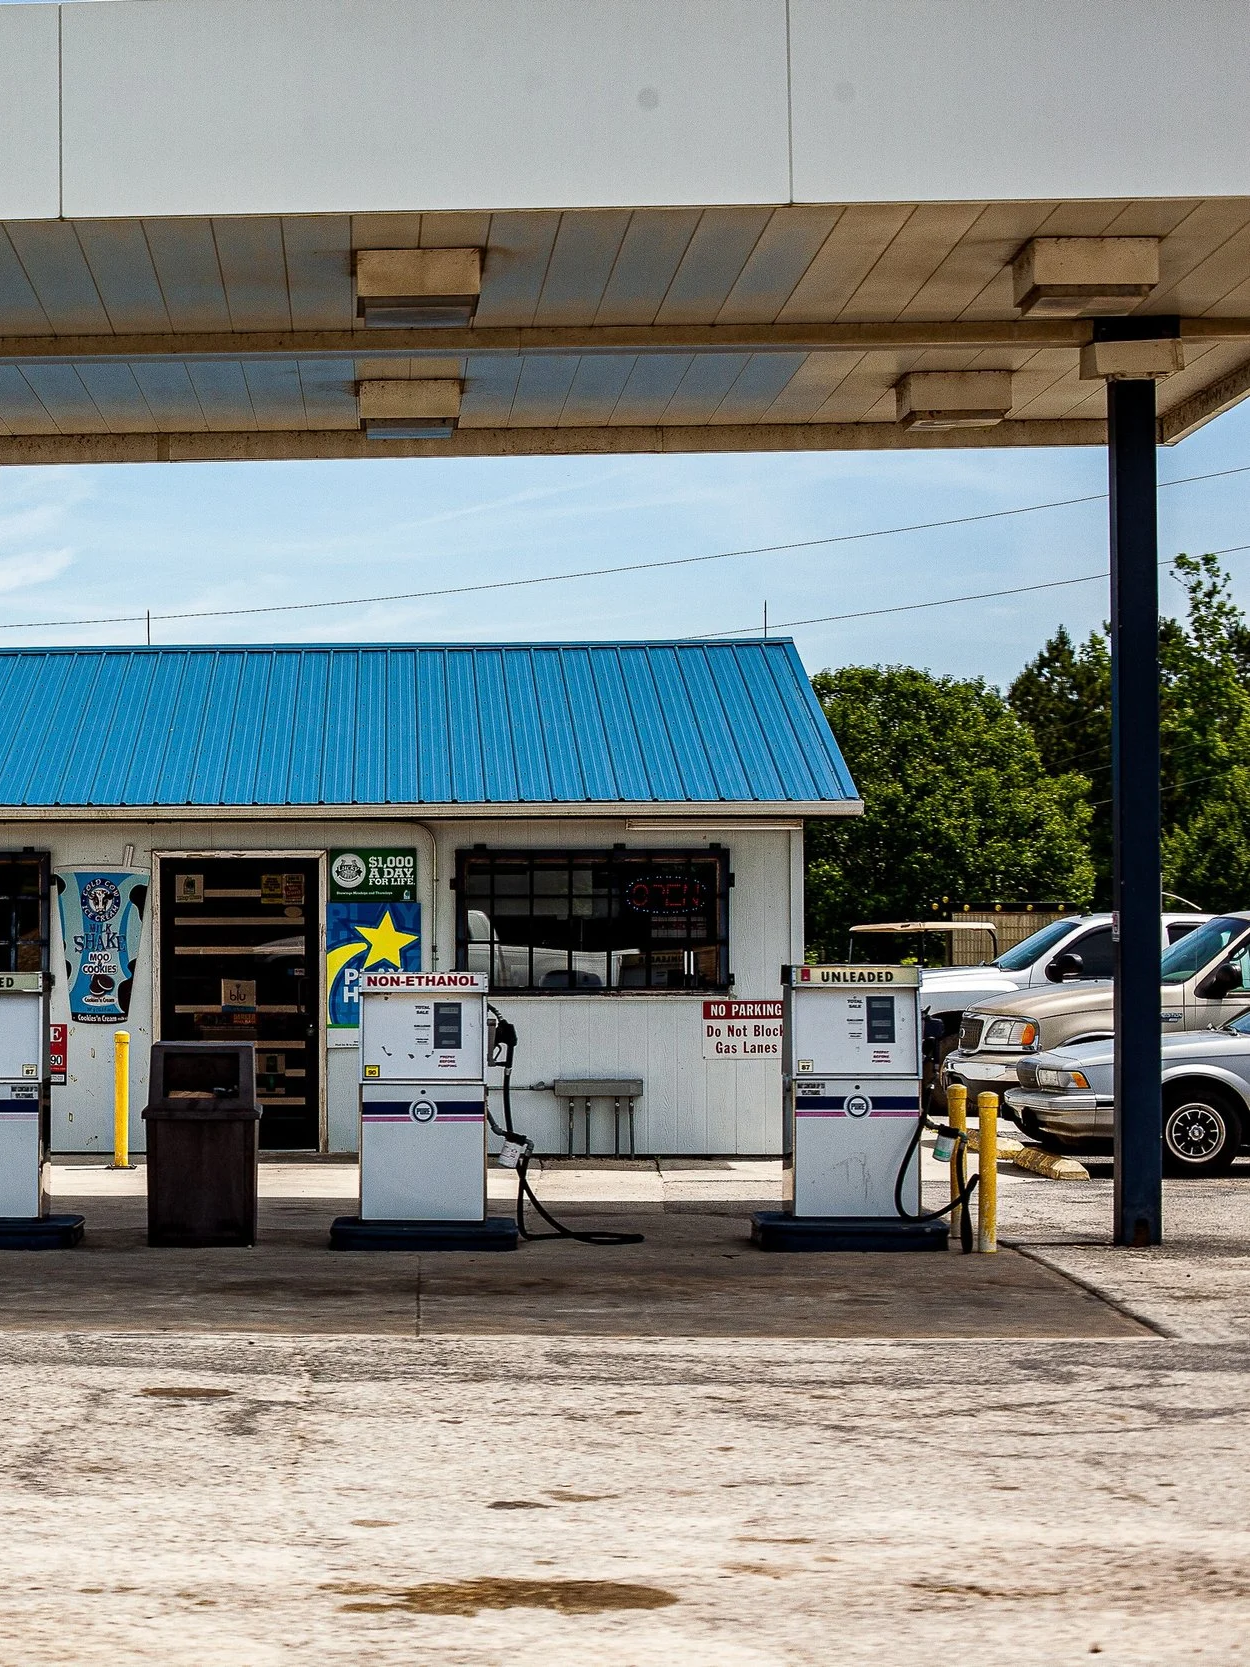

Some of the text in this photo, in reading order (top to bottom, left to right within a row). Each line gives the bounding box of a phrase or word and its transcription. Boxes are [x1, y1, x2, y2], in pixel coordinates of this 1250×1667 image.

[368, 856, 414, 868] $1,000
[368, 868, 380, 878] A
[82, 878, 120, 897] COLD COW
[368, 878, 416, 886] FOR LIFE.
[82, 905, 119, 922] ICE CREAM
[90, 923, 112, 933] MILK
[73, 932, 126, 953] SHAKE
[90, 953, 110, 961] MOO
[83, 965, 117, 973] COOKIES
[366, 975, 479, 987] NON-ETHANOL
[821, 971, 894, 982] UNLEADED
[229, 990, 247, 1002] blu
[710, 1003, 782, 1016] NO PARKING
[102, 1014, 117, 1022] Cream
[706, 1025, 721, 1037] Do
[727, 1025, 747, 1037] Not
[716, 1041, 778, 1054] Gas Lanes
